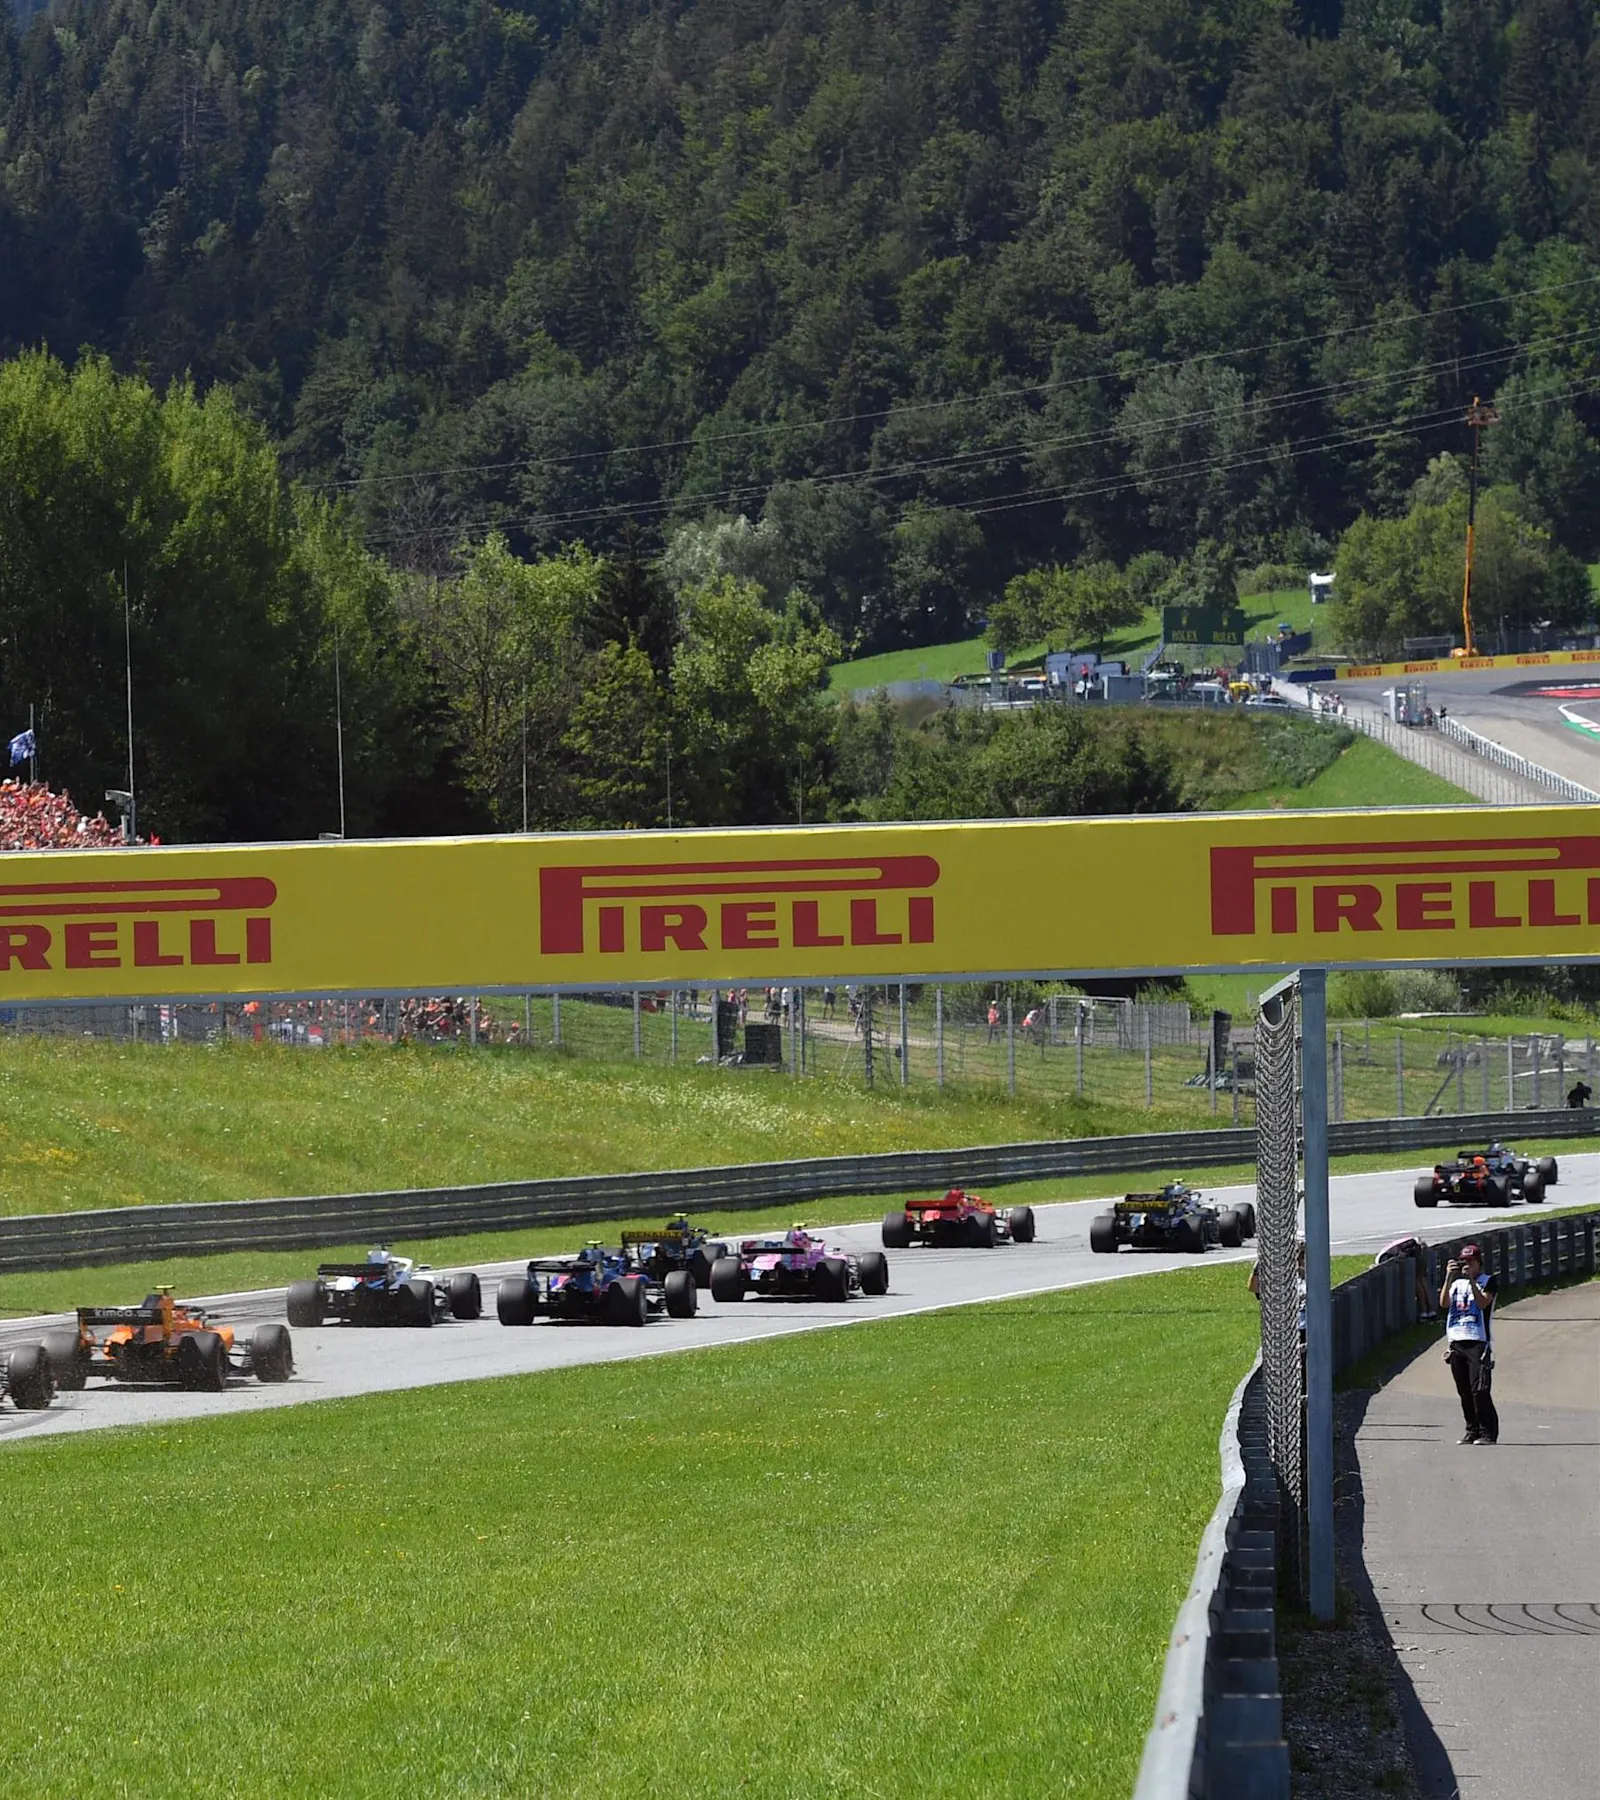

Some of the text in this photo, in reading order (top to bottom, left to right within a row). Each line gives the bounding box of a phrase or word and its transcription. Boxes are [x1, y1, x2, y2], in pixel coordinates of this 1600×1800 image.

[1348, 666, 1382, 678] PIRELLI
[1404, 662, 1438, 673] PIRELLI
[538, 855, 940, 955] PIRELLI
[628, 1231, 682, 1239] RENAULT
